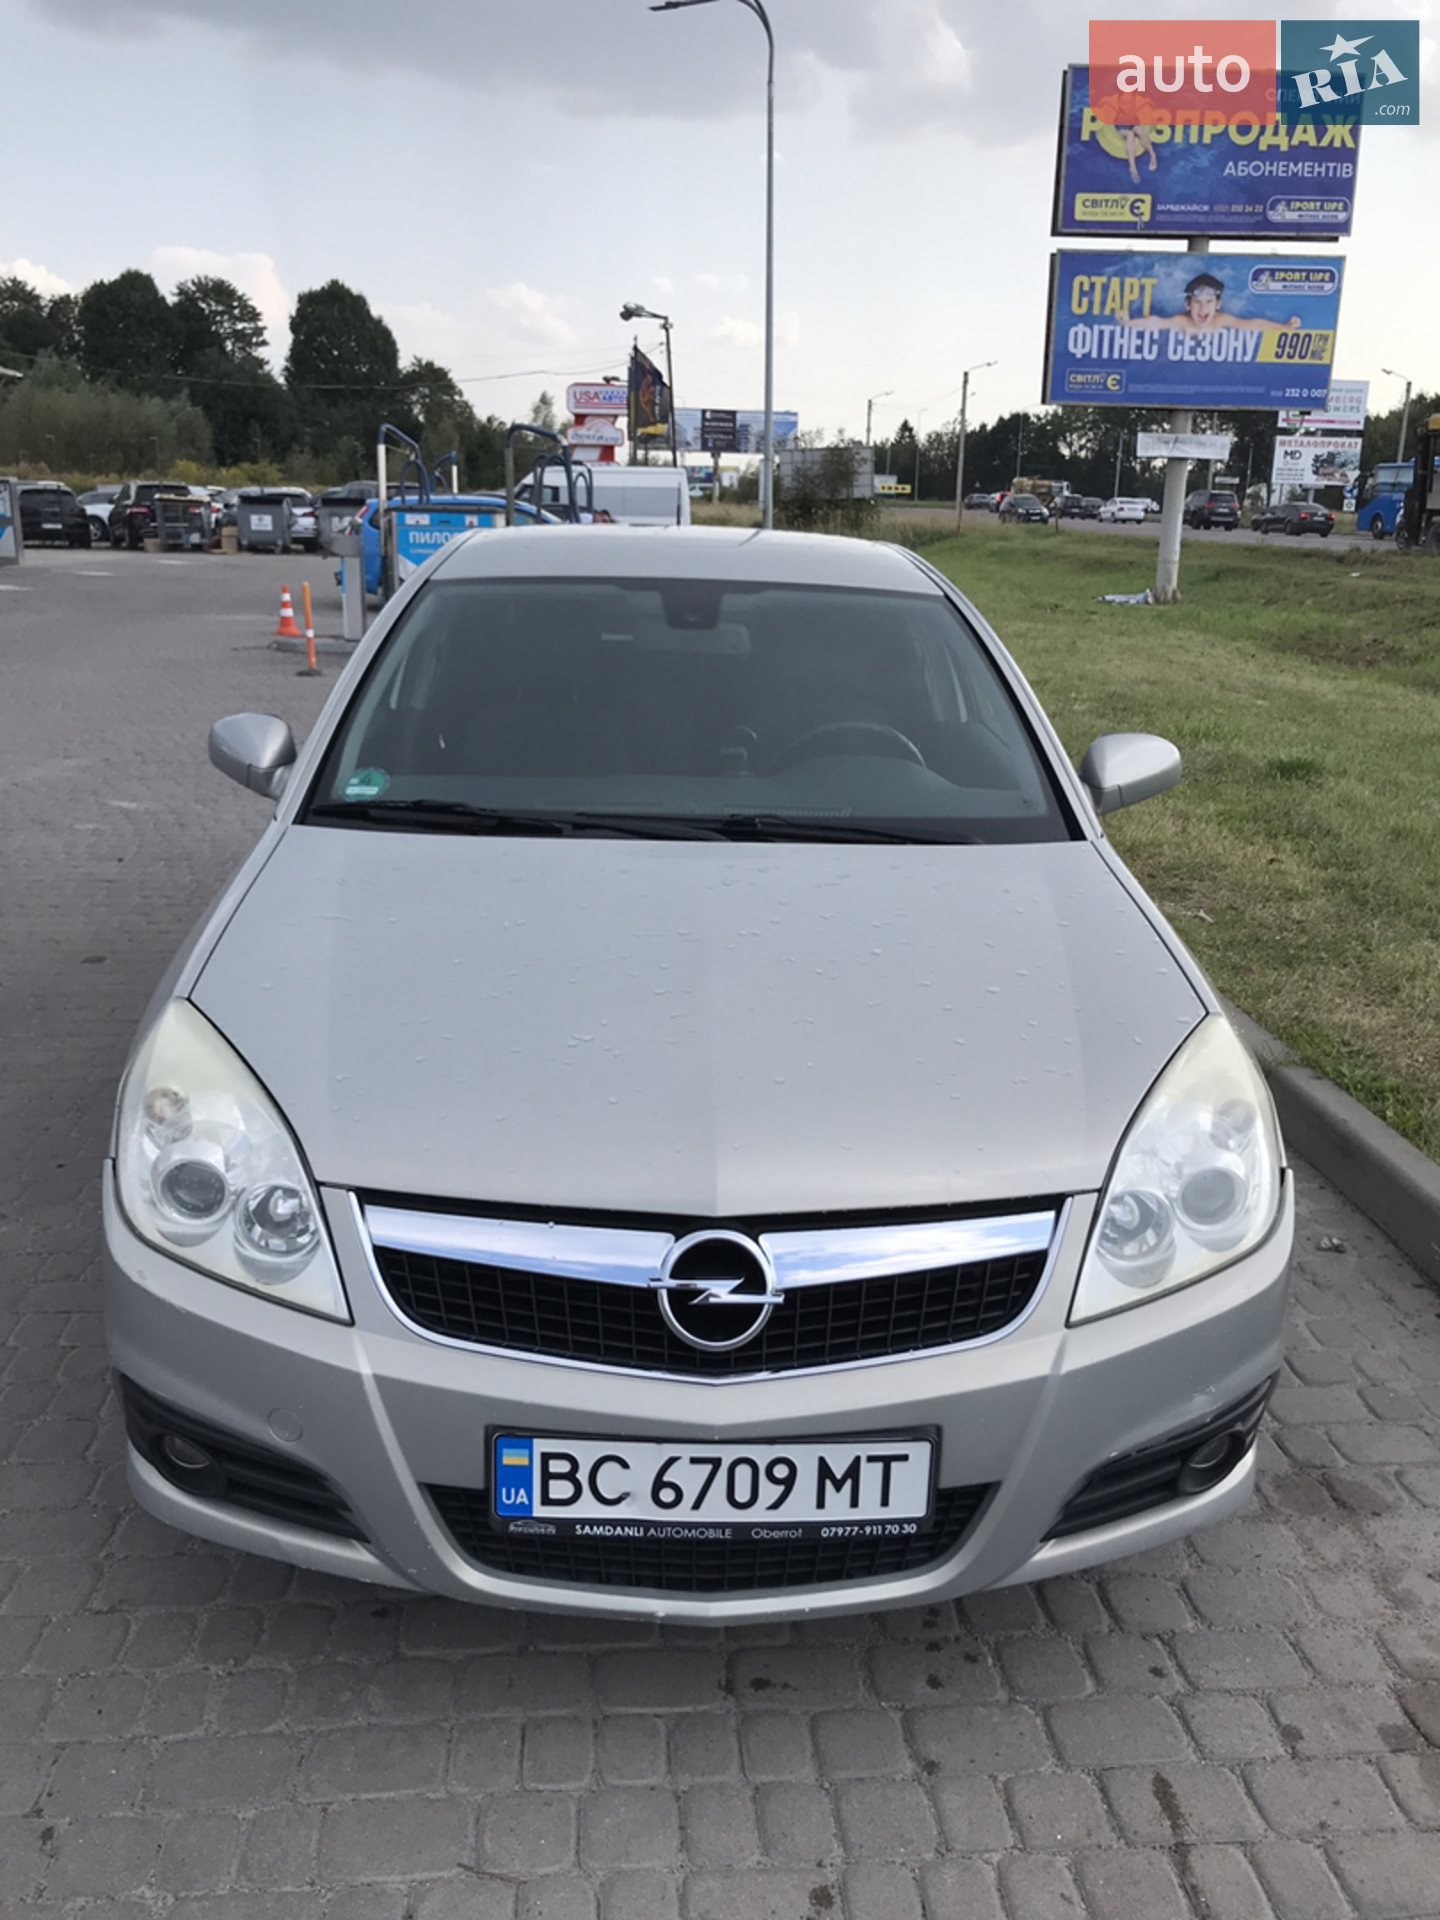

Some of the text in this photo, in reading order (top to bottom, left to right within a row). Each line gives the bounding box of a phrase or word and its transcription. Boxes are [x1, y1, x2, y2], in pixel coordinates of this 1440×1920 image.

[1223, 161, 1354, 178] АБОНЕМЕНТІВ
[1290, 201, 1320, 211] SPORT
[1275, 271, 1307, 281] SPORT
[1071, 275, 1158, 318] СТАРТ
[1067, 323, 1260, 363] ФІТНЕС СЕЗОНУ
[1274, 332, 1313, 360] 990
[573, 390, 601, 402] USA
[1285, 388, 1300, 397] 232
[1301, 388, 1309, 397] 0
[1310, 388, 1328, 398] 007
[1279, 439, 1359, 449] МЕТАЛОПРОКАТ
[409, 531, 460, 545] ПИЛО
[539, 1451, 910, 1511] BC 6709 MT
[501, 1486, 529, 1505] UA
[575, 1524, 732, 1539] SAMDANLI AUTOMOBILE
[751, 1527, 803, 1539] Oberrot
